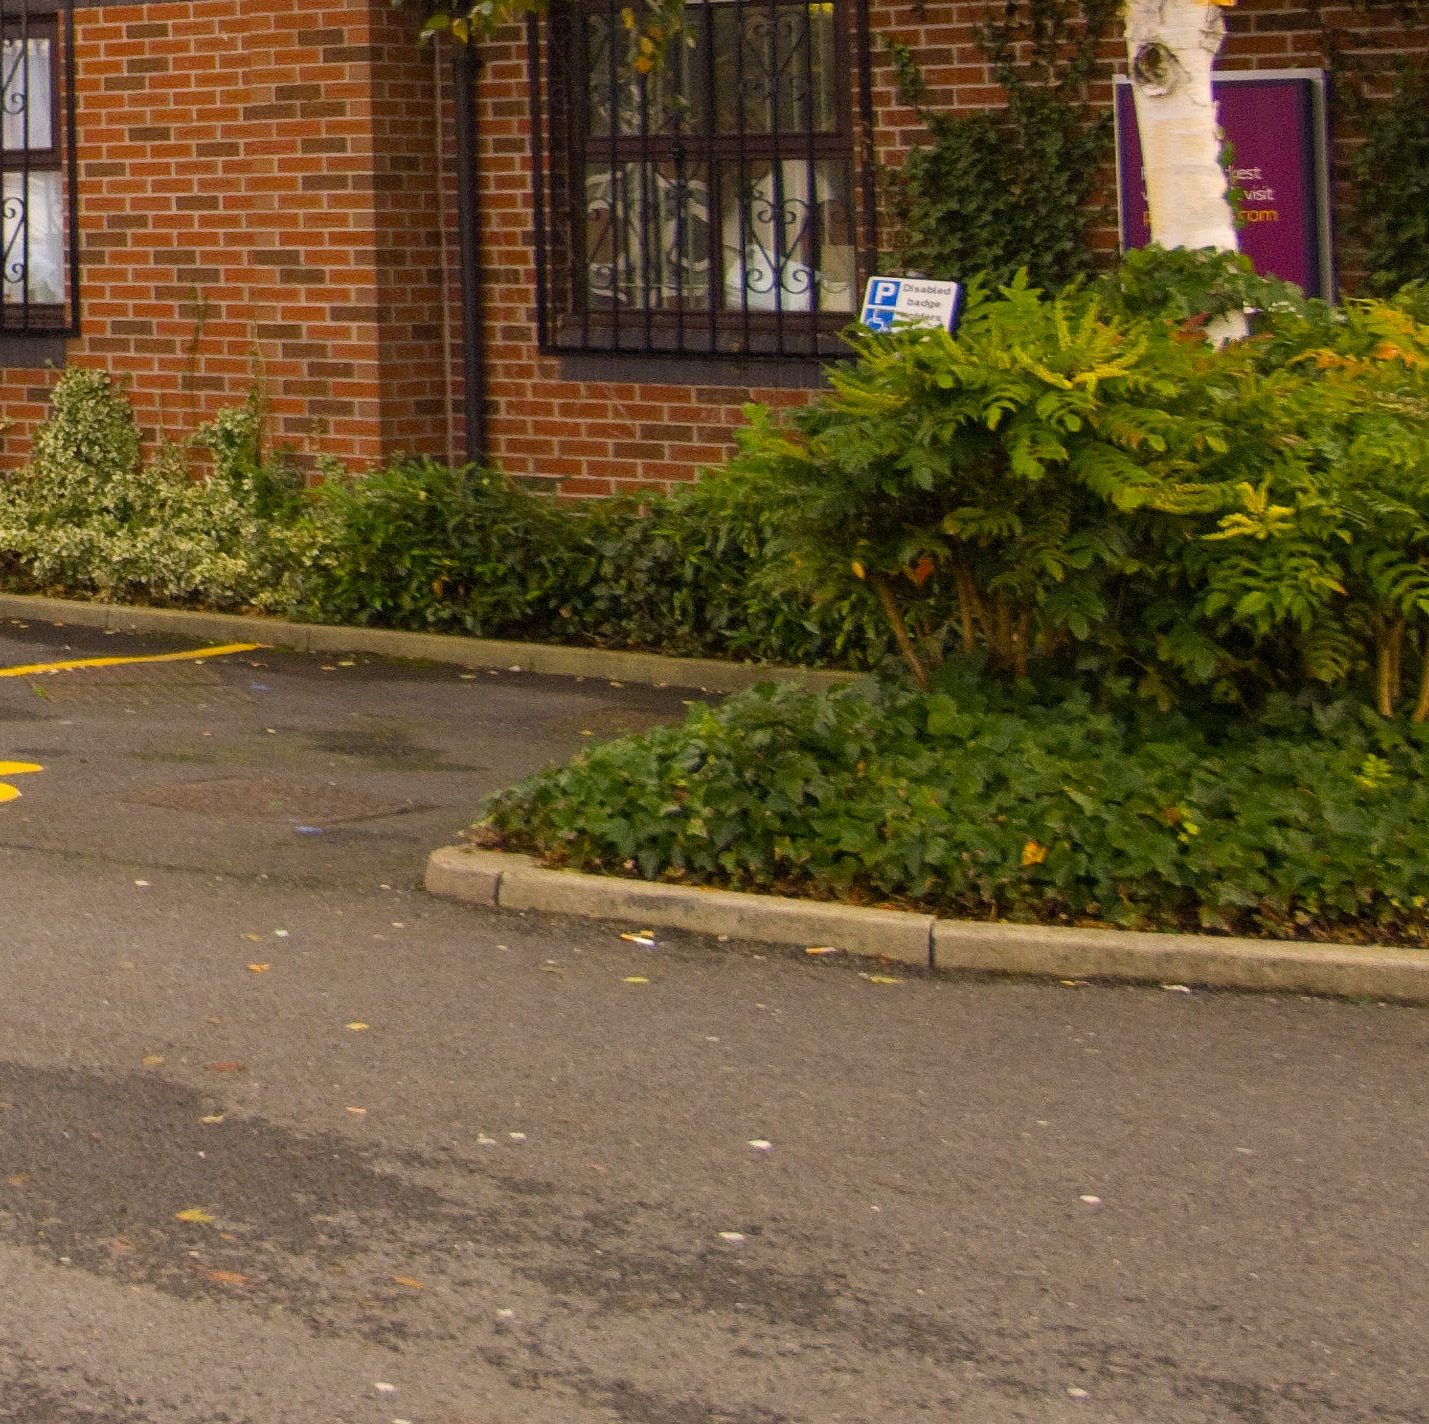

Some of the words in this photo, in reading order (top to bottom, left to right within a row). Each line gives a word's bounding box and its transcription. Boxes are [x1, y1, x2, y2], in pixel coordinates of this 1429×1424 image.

[874, 282, 896, 304] P
[903, 283, 951, 295] Disabled
[907, 297, 941, 309] badge
